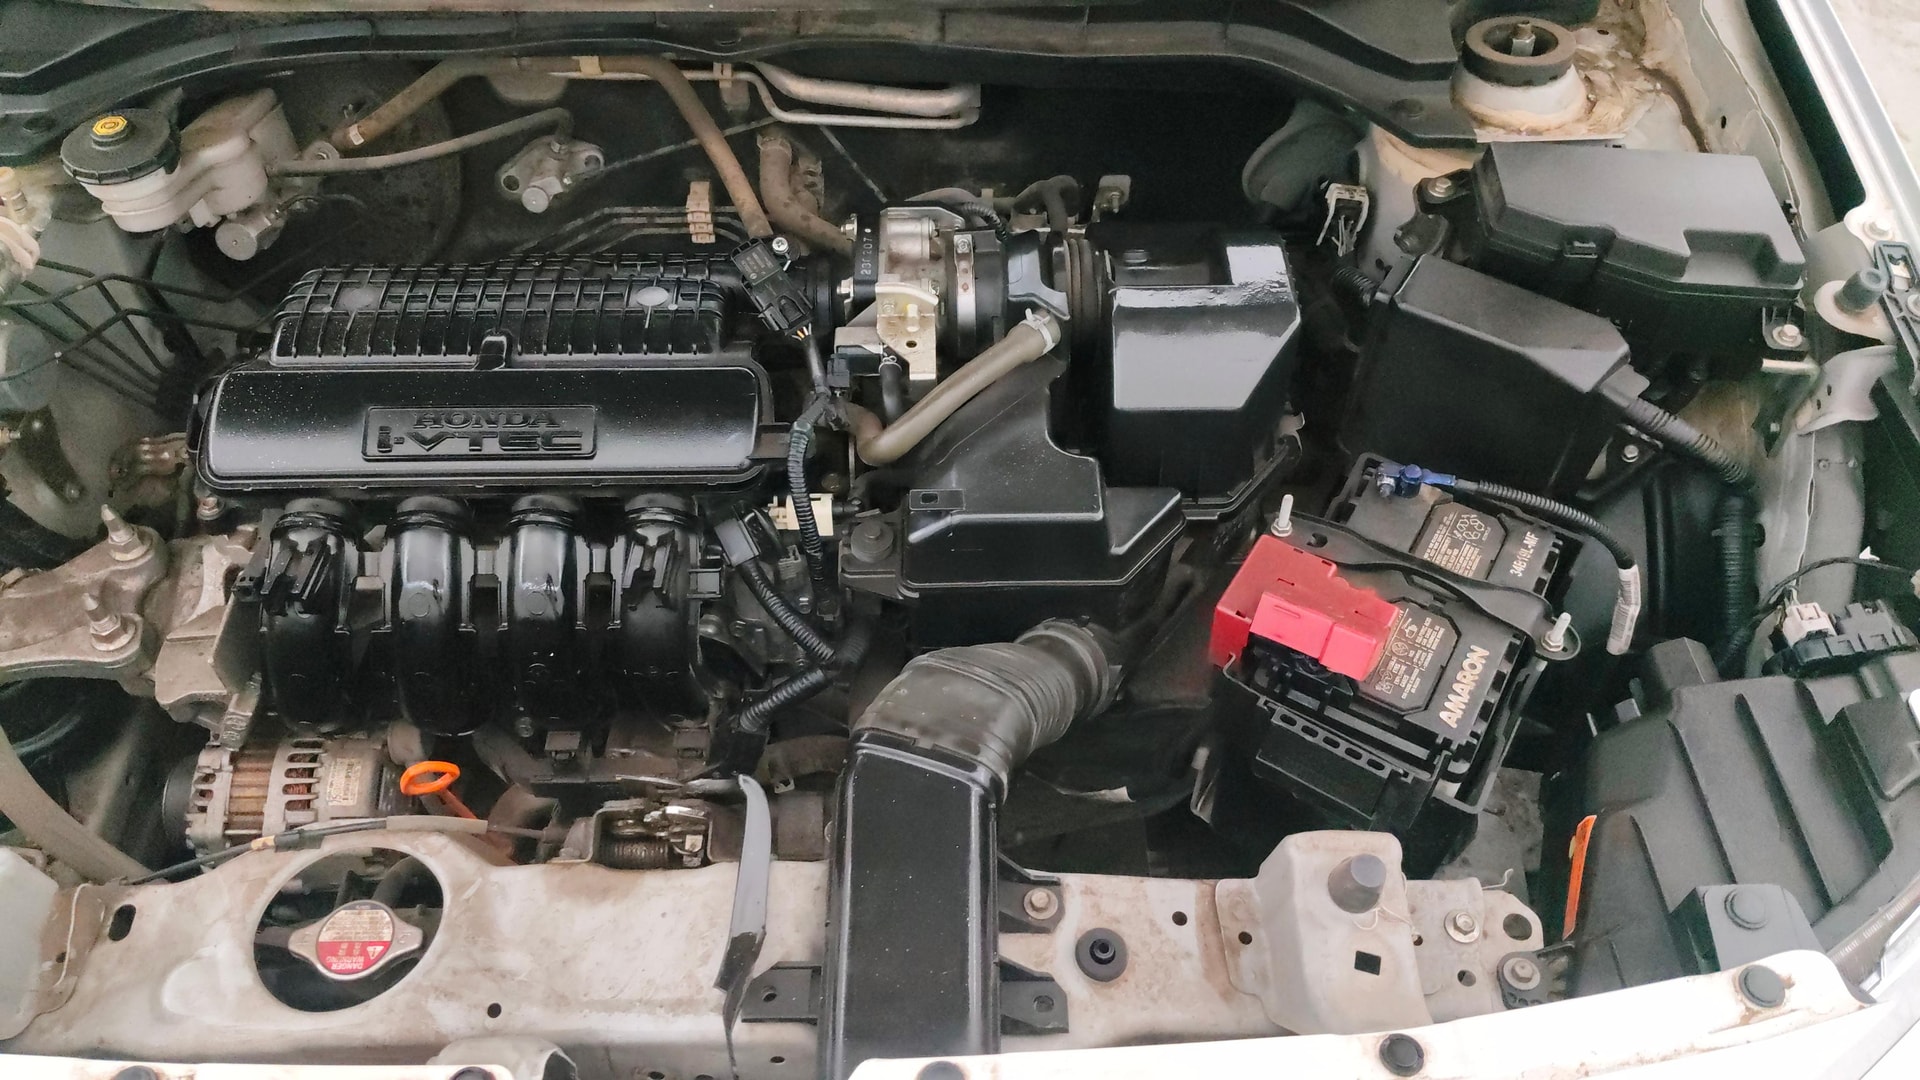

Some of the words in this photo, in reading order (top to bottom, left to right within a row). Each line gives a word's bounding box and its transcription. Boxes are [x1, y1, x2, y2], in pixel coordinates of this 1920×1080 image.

[413, 411, 560, 429] HONDA
[1439, 644, 1490, 729] AMARON
[331, 962, 363, 970] DANGER
